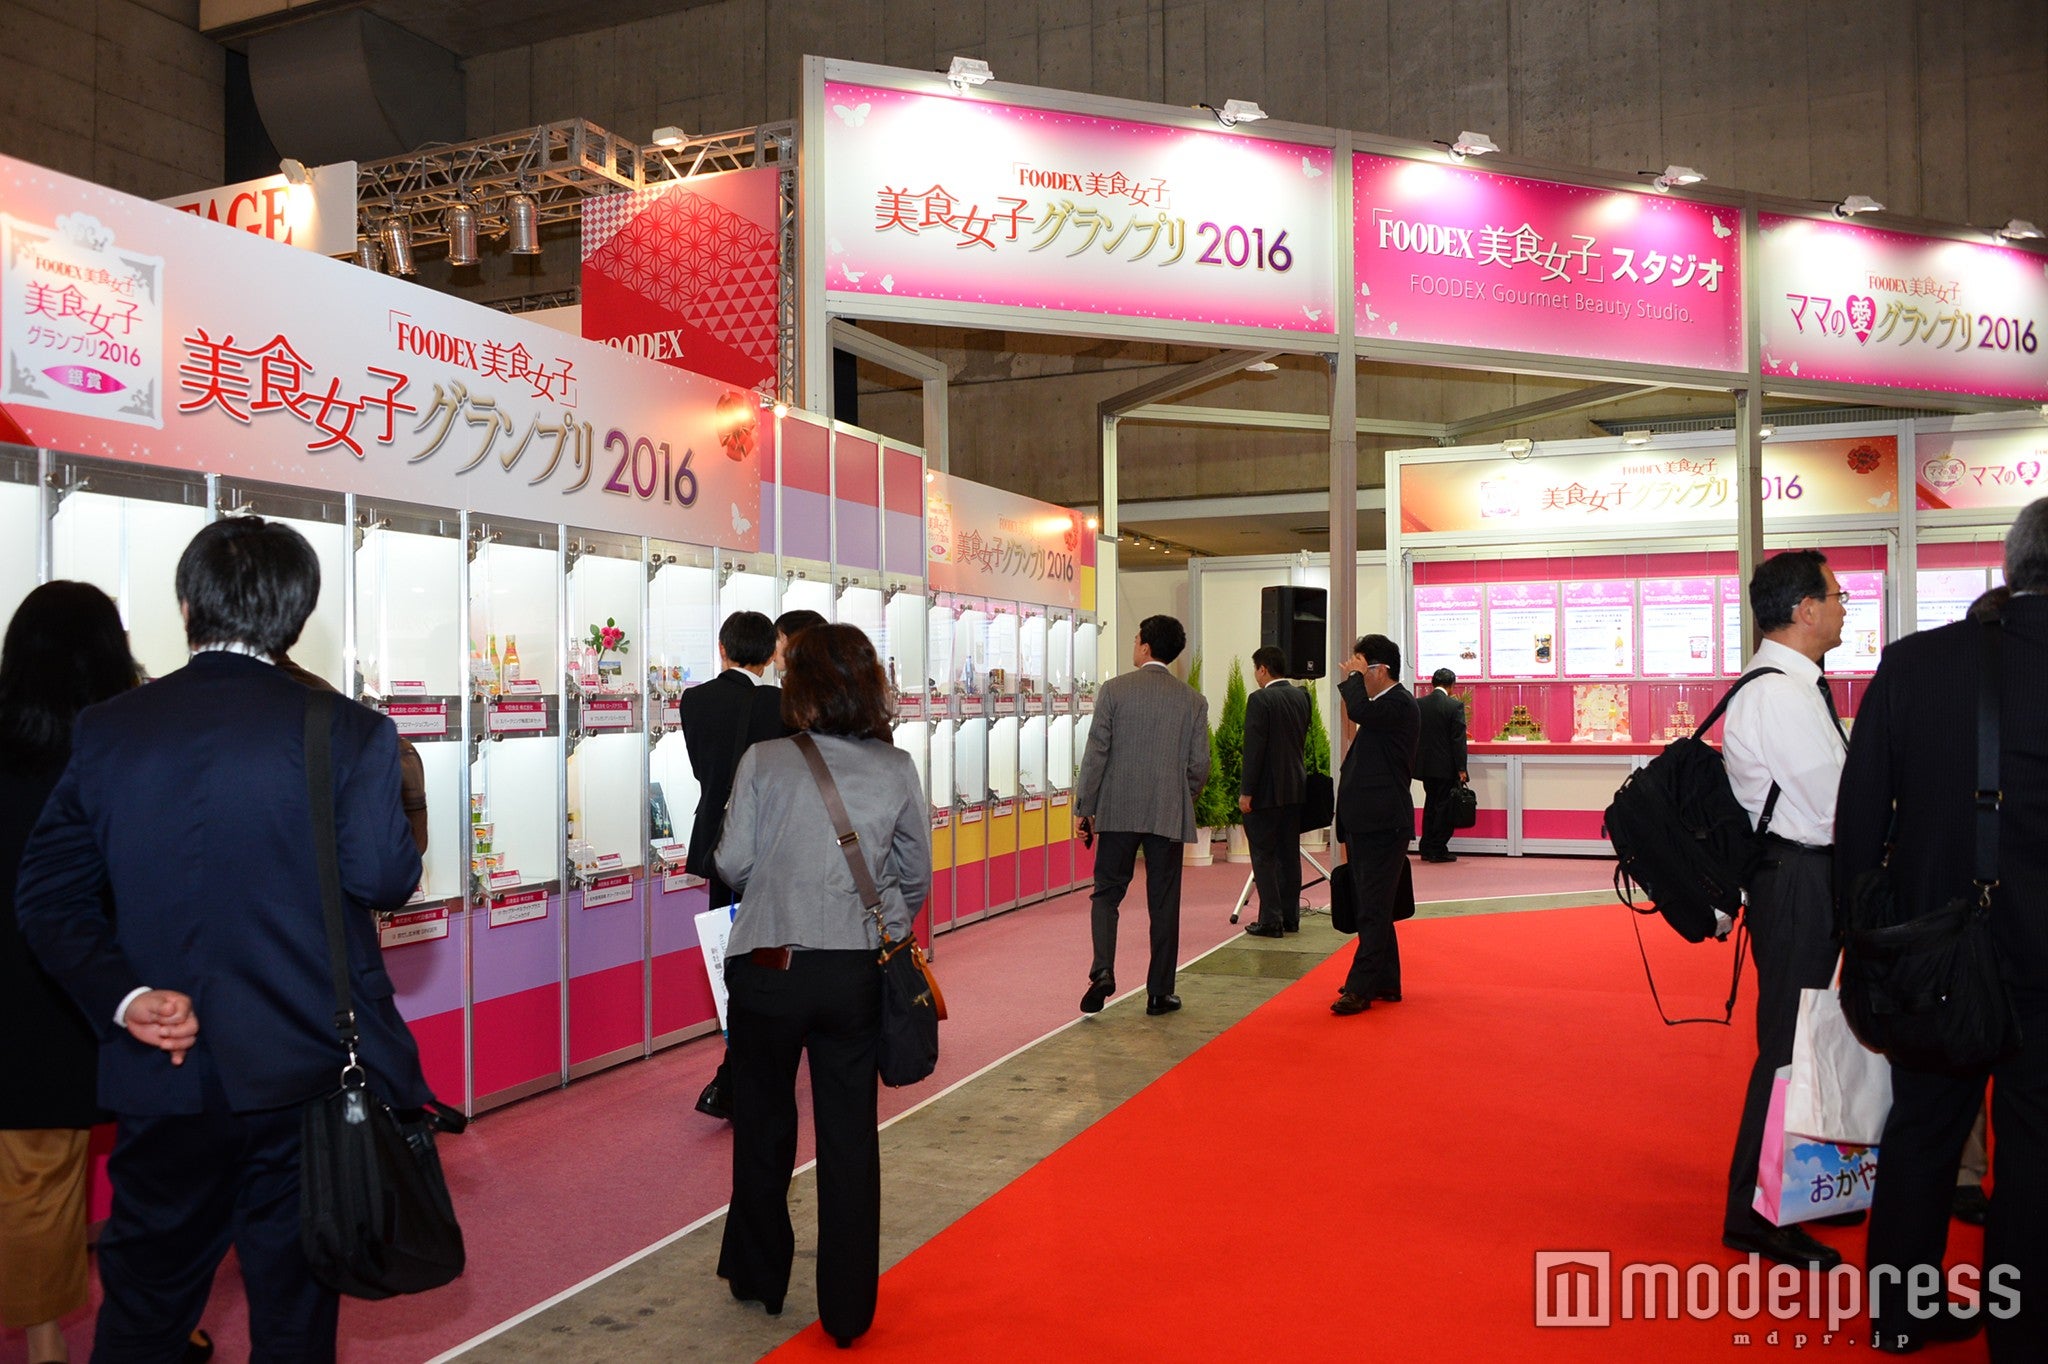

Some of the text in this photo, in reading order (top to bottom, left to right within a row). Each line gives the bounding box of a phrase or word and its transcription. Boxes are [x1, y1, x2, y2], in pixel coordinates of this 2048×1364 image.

[1195, 221, 1295, 274] 2016
[24, 280, 144, 340] 美食女子
[1410, 274, 1694, 323] FOODEX Gourmet Beauty Studio.
[1977, 315, 2038, 354] 2016
[602, 427, 700, 508] 2016
[1047, 550, 1074, 583] 2016
